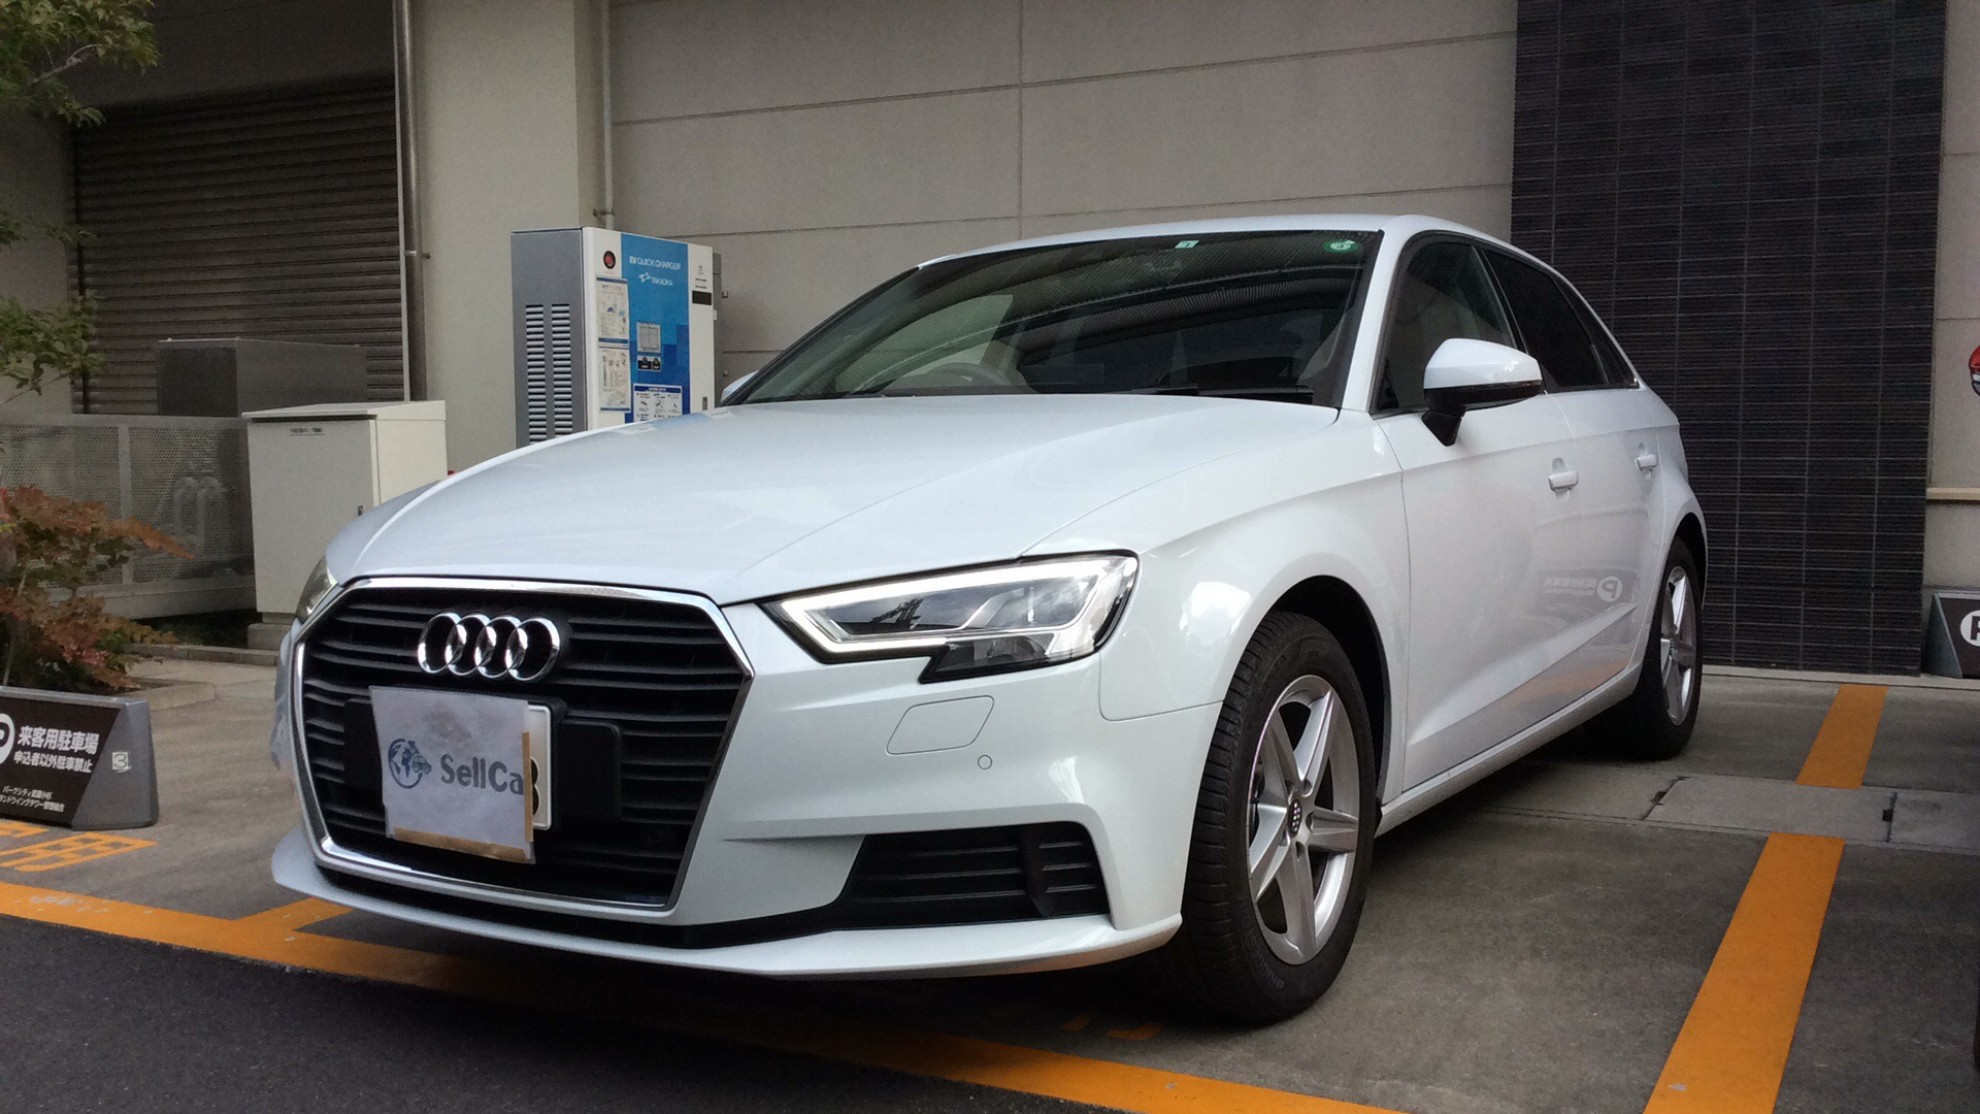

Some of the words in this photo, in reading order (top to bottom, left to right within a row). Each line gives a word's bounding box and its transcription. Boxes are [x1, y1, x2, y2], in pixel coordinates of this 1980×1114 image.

[629, 255, 637, 264] EV
[637, 257, 655, 267] QUICK
[655, 260, 681, 270] CHARGER
[17, 725, 100, 755] 来客用駐車場
[13, 750, 93, 773] 申込者以外駐車禁止
[114, 753, 128, 769] 3
[440, 753, 524, 795] SellCa
